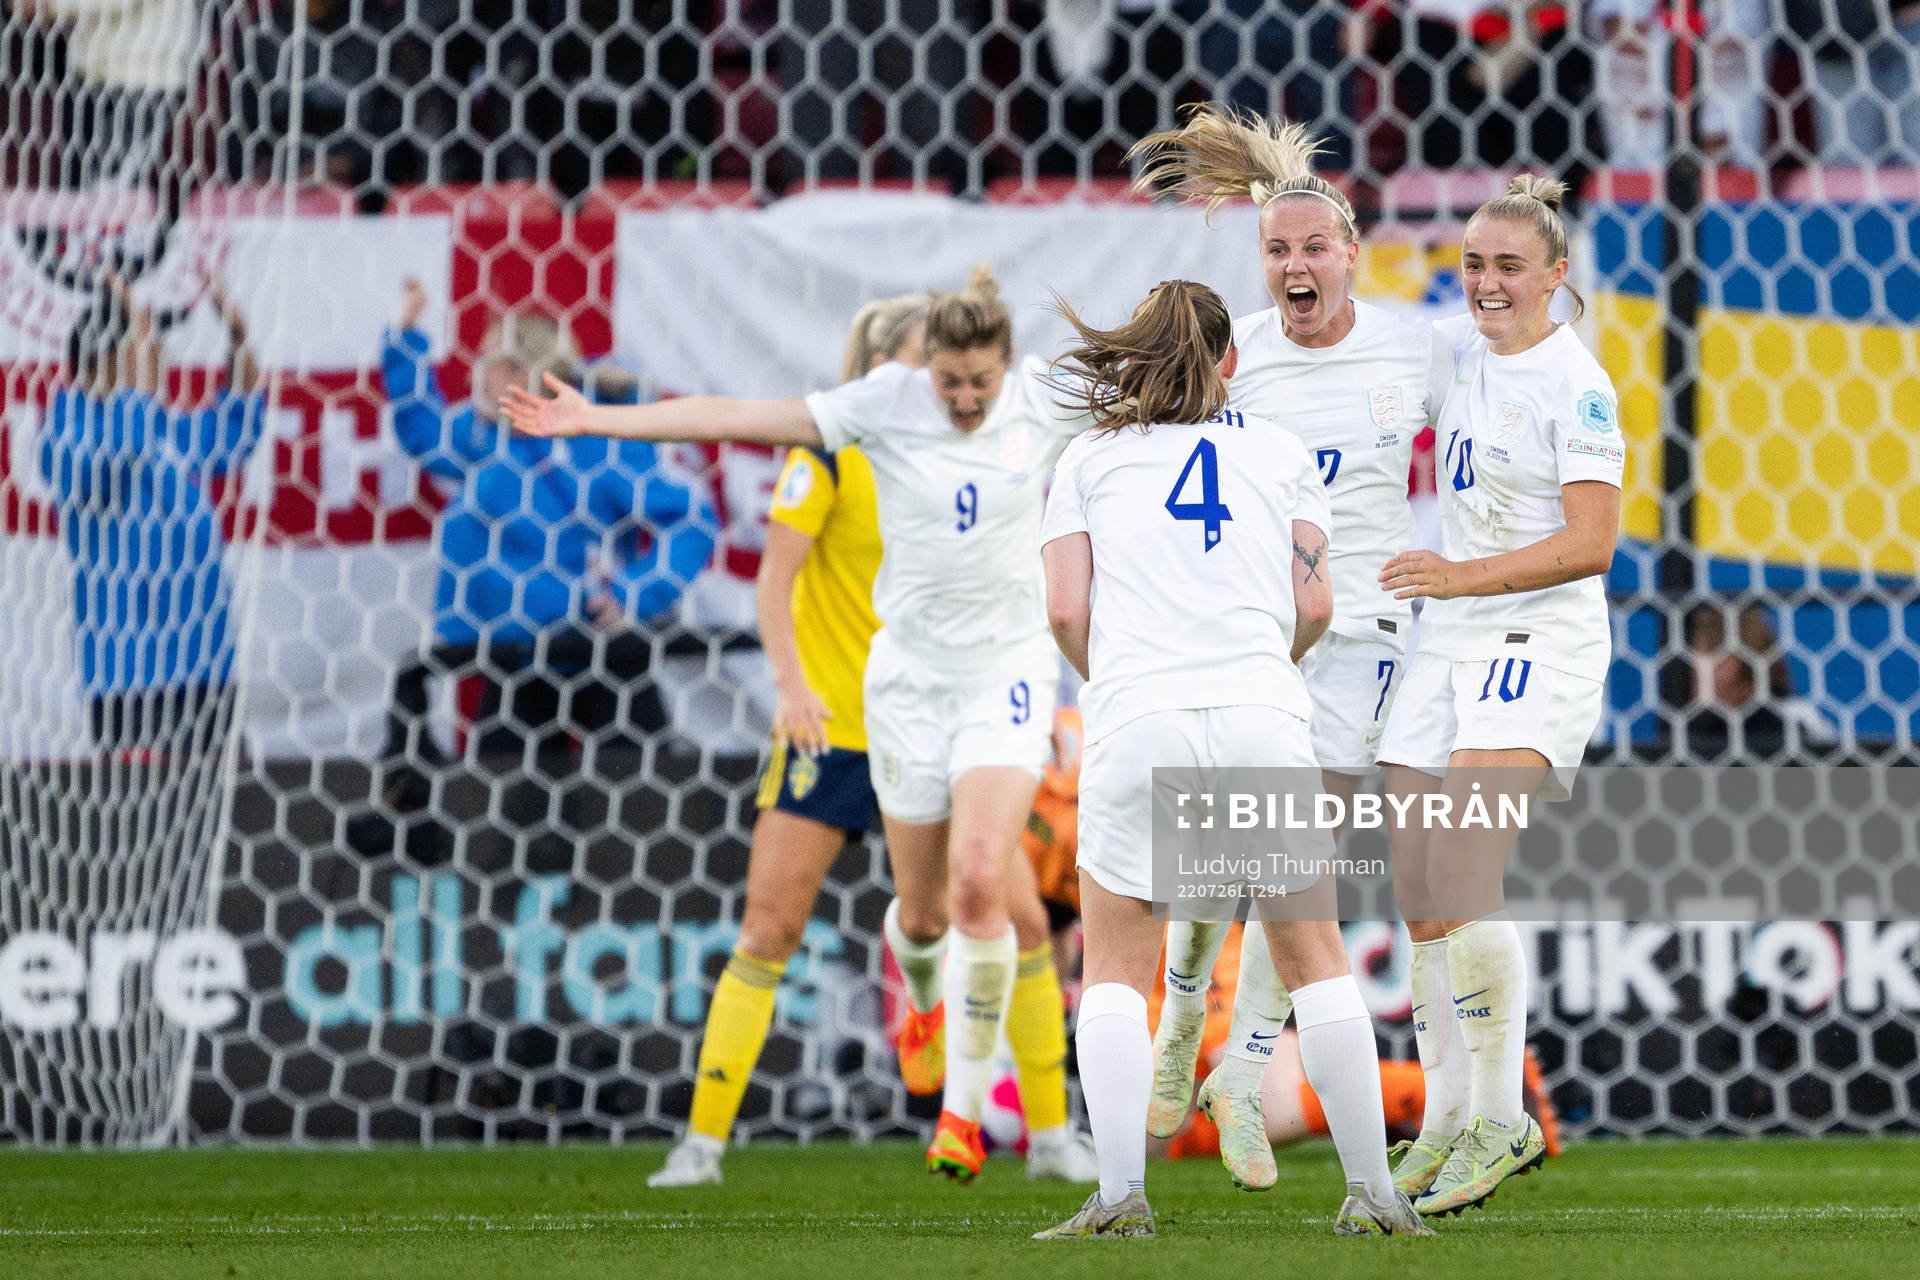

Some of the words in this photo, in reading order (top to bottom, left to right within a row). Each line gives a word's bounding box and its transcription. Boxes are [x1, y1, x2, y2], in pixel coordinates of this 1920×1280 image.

[1446, 427, 1475, 493] 10
[1567, 443, 1623, 458] FOUNDATION
[956, 482, 978, 533] 9
[1165, 437, 1233, 553] 4
[1010, 680, 1030, 725] 9
[1374, 660, 1395, 721] 7
[1477, 658, 1532, 703] 10
[284, 875, 463, 1025] all
[1456, 1006, 1492, 1019] Eng
